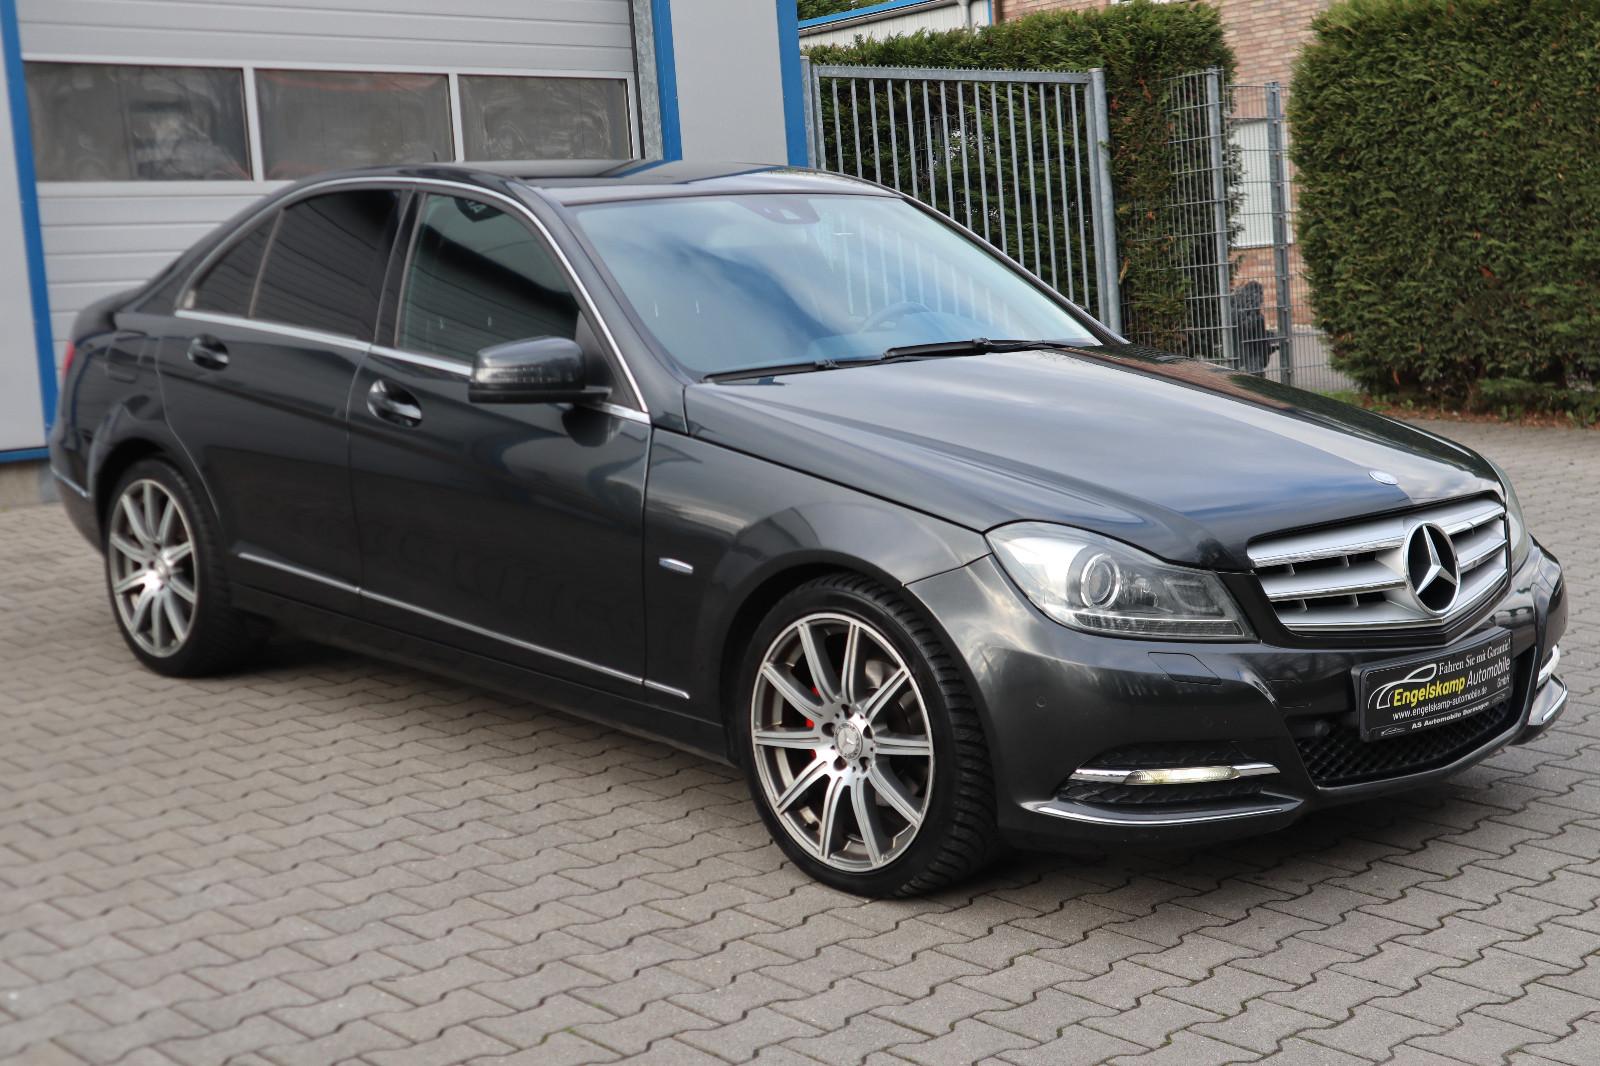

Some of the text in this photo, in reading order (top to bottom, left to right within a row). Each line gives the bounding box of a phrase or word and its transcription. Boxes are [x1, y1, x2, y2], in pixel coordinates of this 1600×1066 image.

[1438, 661, 1464, 675] Fahren
[1465, 655, 1476, 667] Sie
[1476, 650, 1486, 663] mit
[1393, 657, 1511, 707] Engelskamp Automobile
[1392, 687, 1487, 720] www.engelskamp-automobile.de
[1411, 722, 1422, 730] AS
[1424, 713, 1461, 727] Automobile
